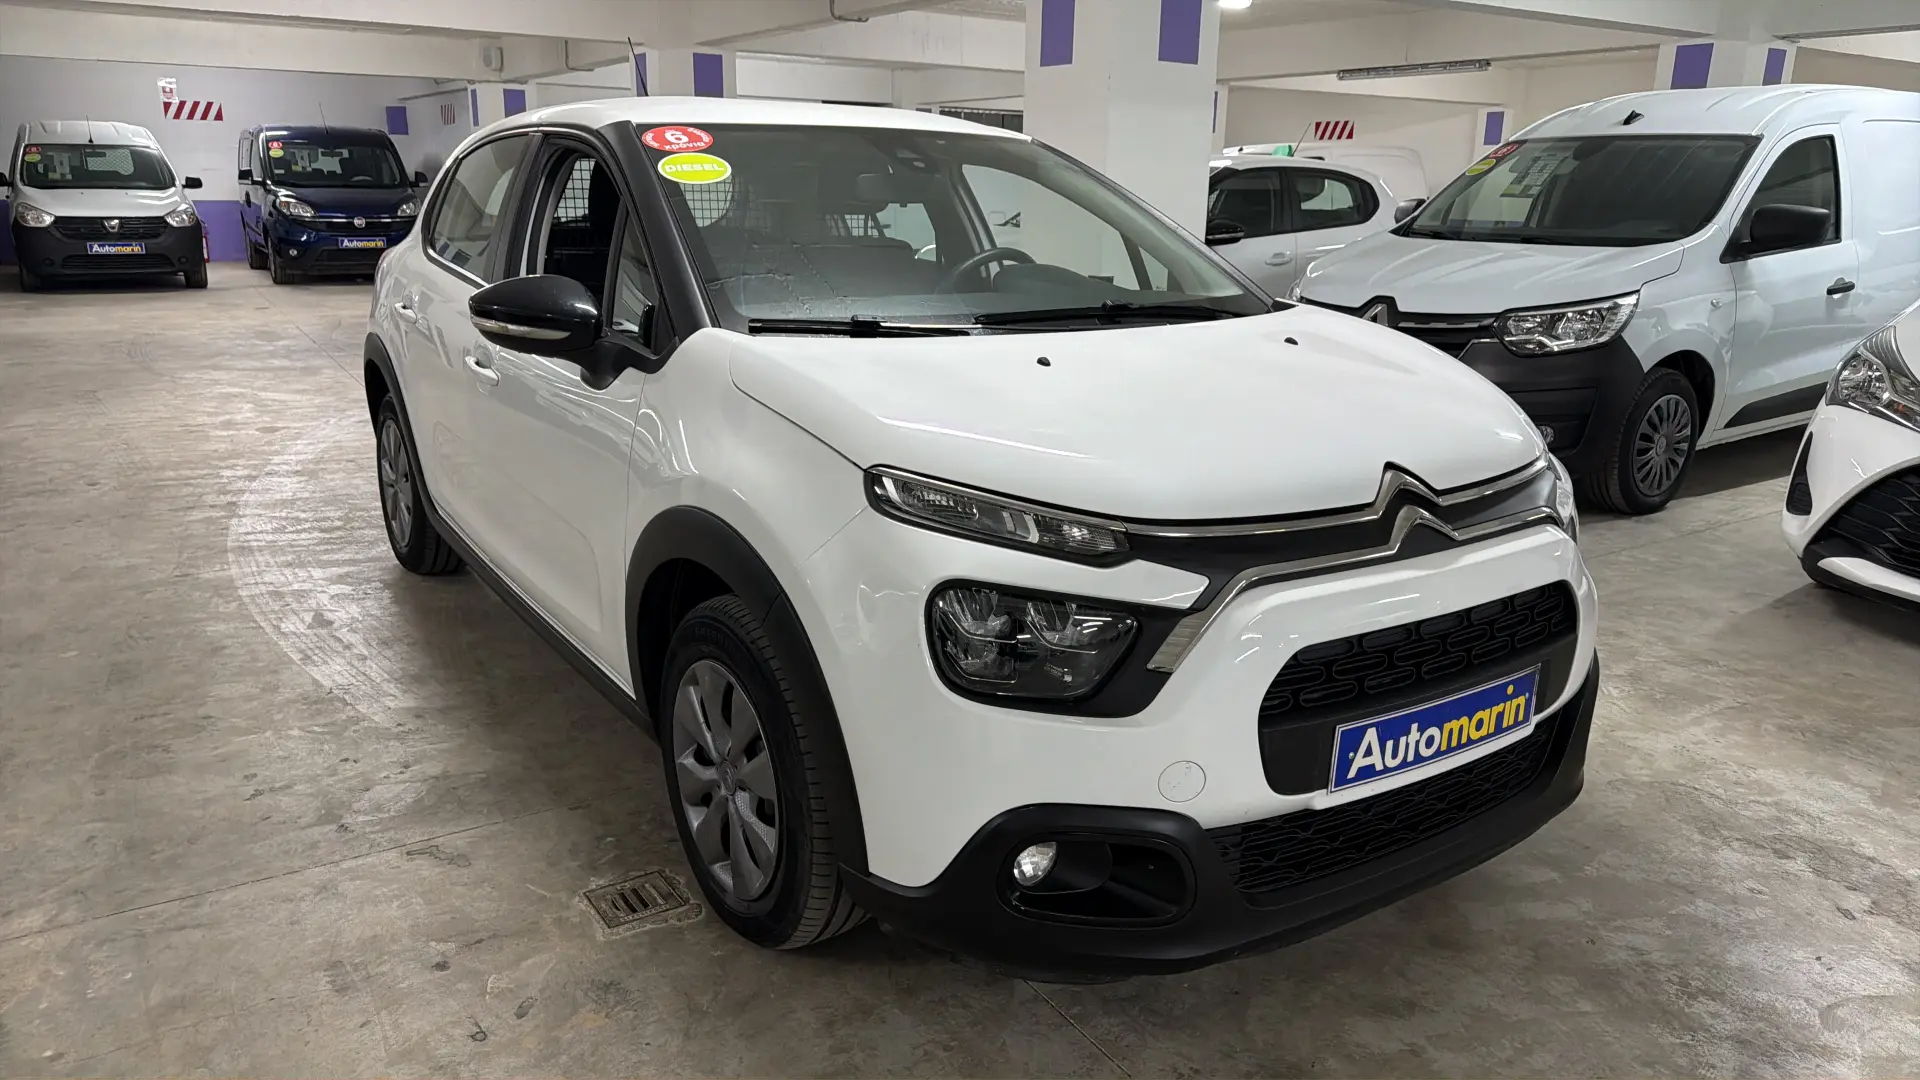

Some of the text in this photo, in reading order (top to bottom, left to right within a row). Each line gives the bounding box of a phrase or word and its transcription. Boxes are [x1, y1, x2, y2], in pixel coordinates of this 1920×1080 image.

[664, 131, 689, 144] 6
[665, 164, 724, 172] DIESEL
[92, 242, 142, 253] Automarin
[342, 239, 384, 248] Automarin
[1347, 684, 1527, 779] Automarin
